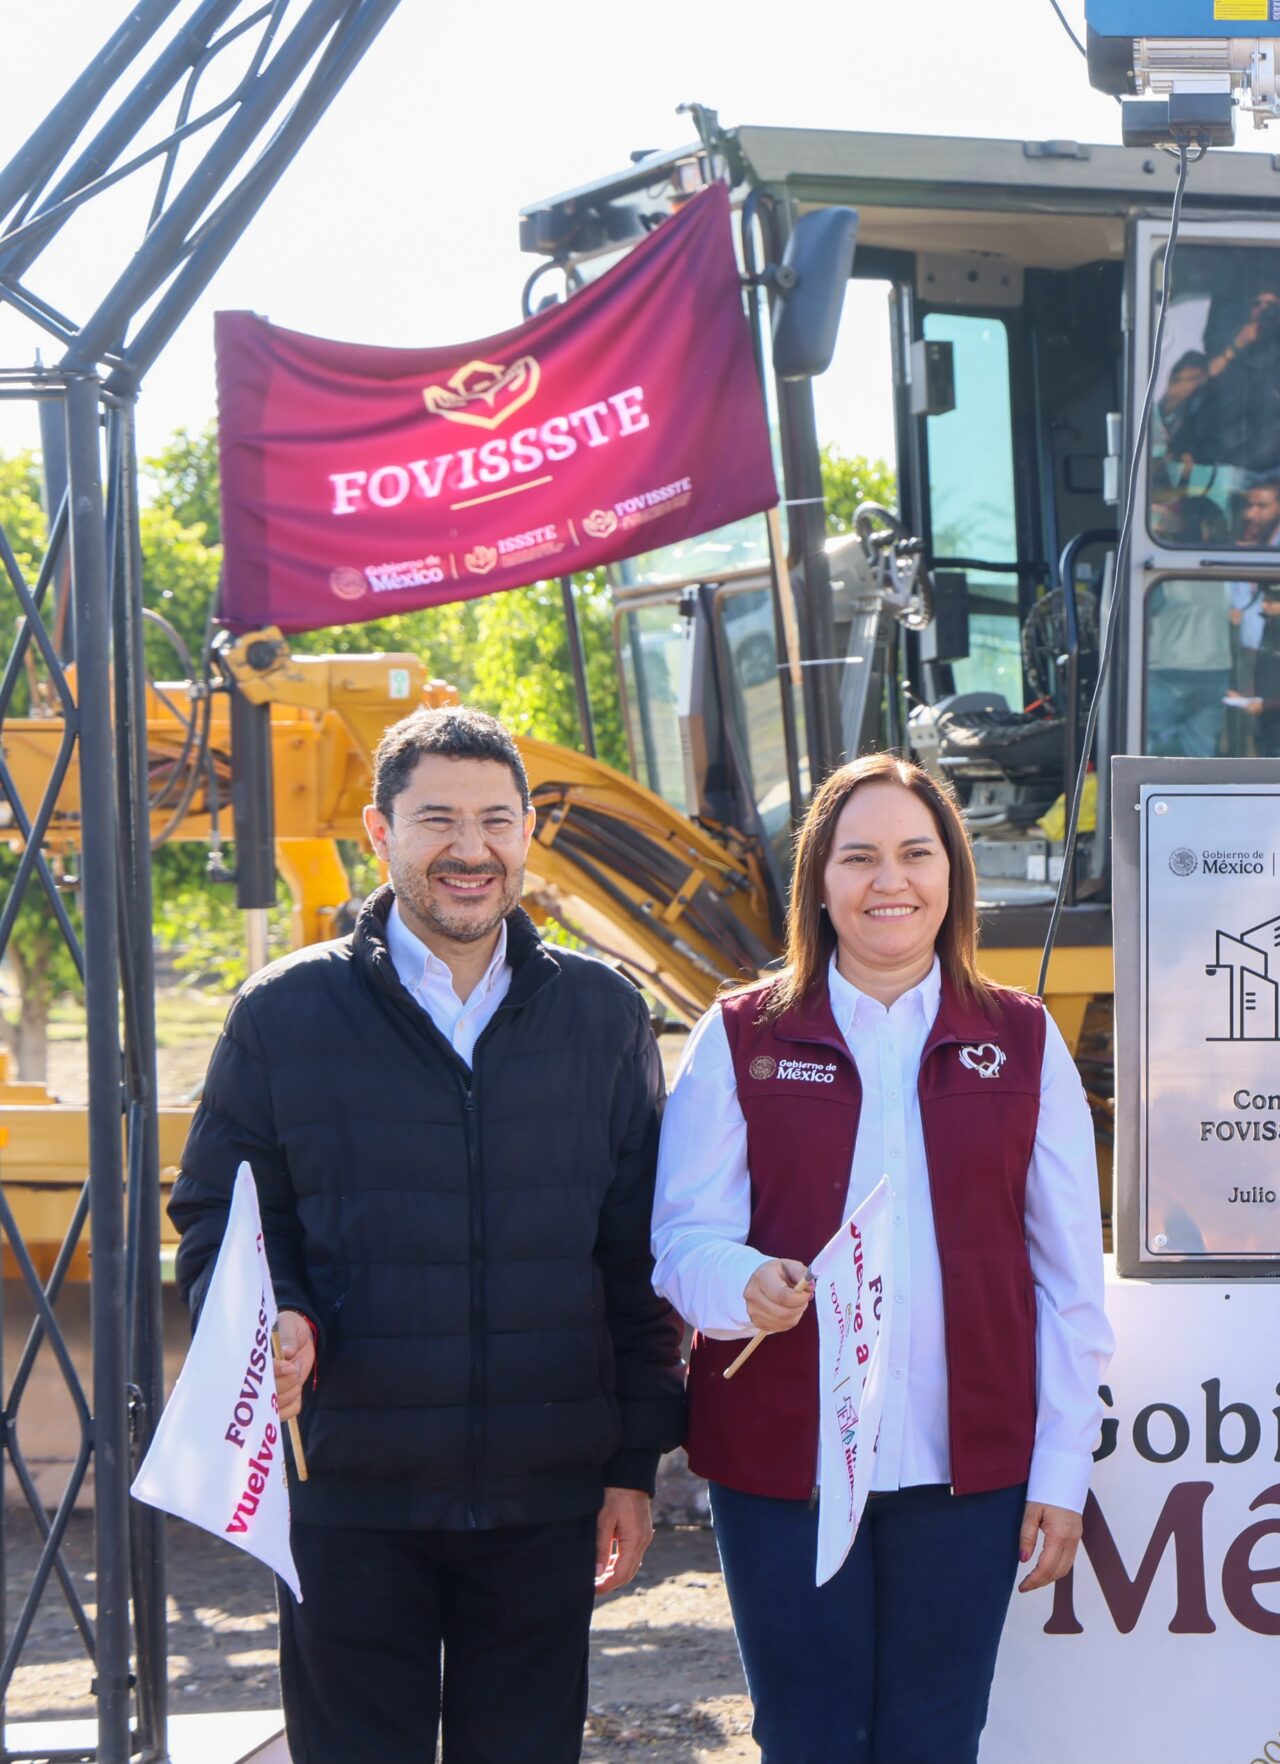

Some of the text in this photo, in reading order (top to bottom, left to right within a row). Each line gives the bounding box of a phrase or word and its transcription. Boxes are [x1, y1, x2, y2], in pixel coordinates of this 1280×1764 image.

[328, 385, 650, 516] FOVISSSTE
[497, 524, 557, 554] ISSSTE
[369, 567, 444, 592] México
[1202, 850, 1264, 859] Gobierno de
[1202, 860, 1264, 874] México
[780, 1059, 837, 1071] Gobierno de
[777, 1067, 834, 1083] México
[1228, 1187, 1276, 1204] Julio
[856, 1343, 869, 1365] a
[226, 1423, 277, 1533] vuelve
